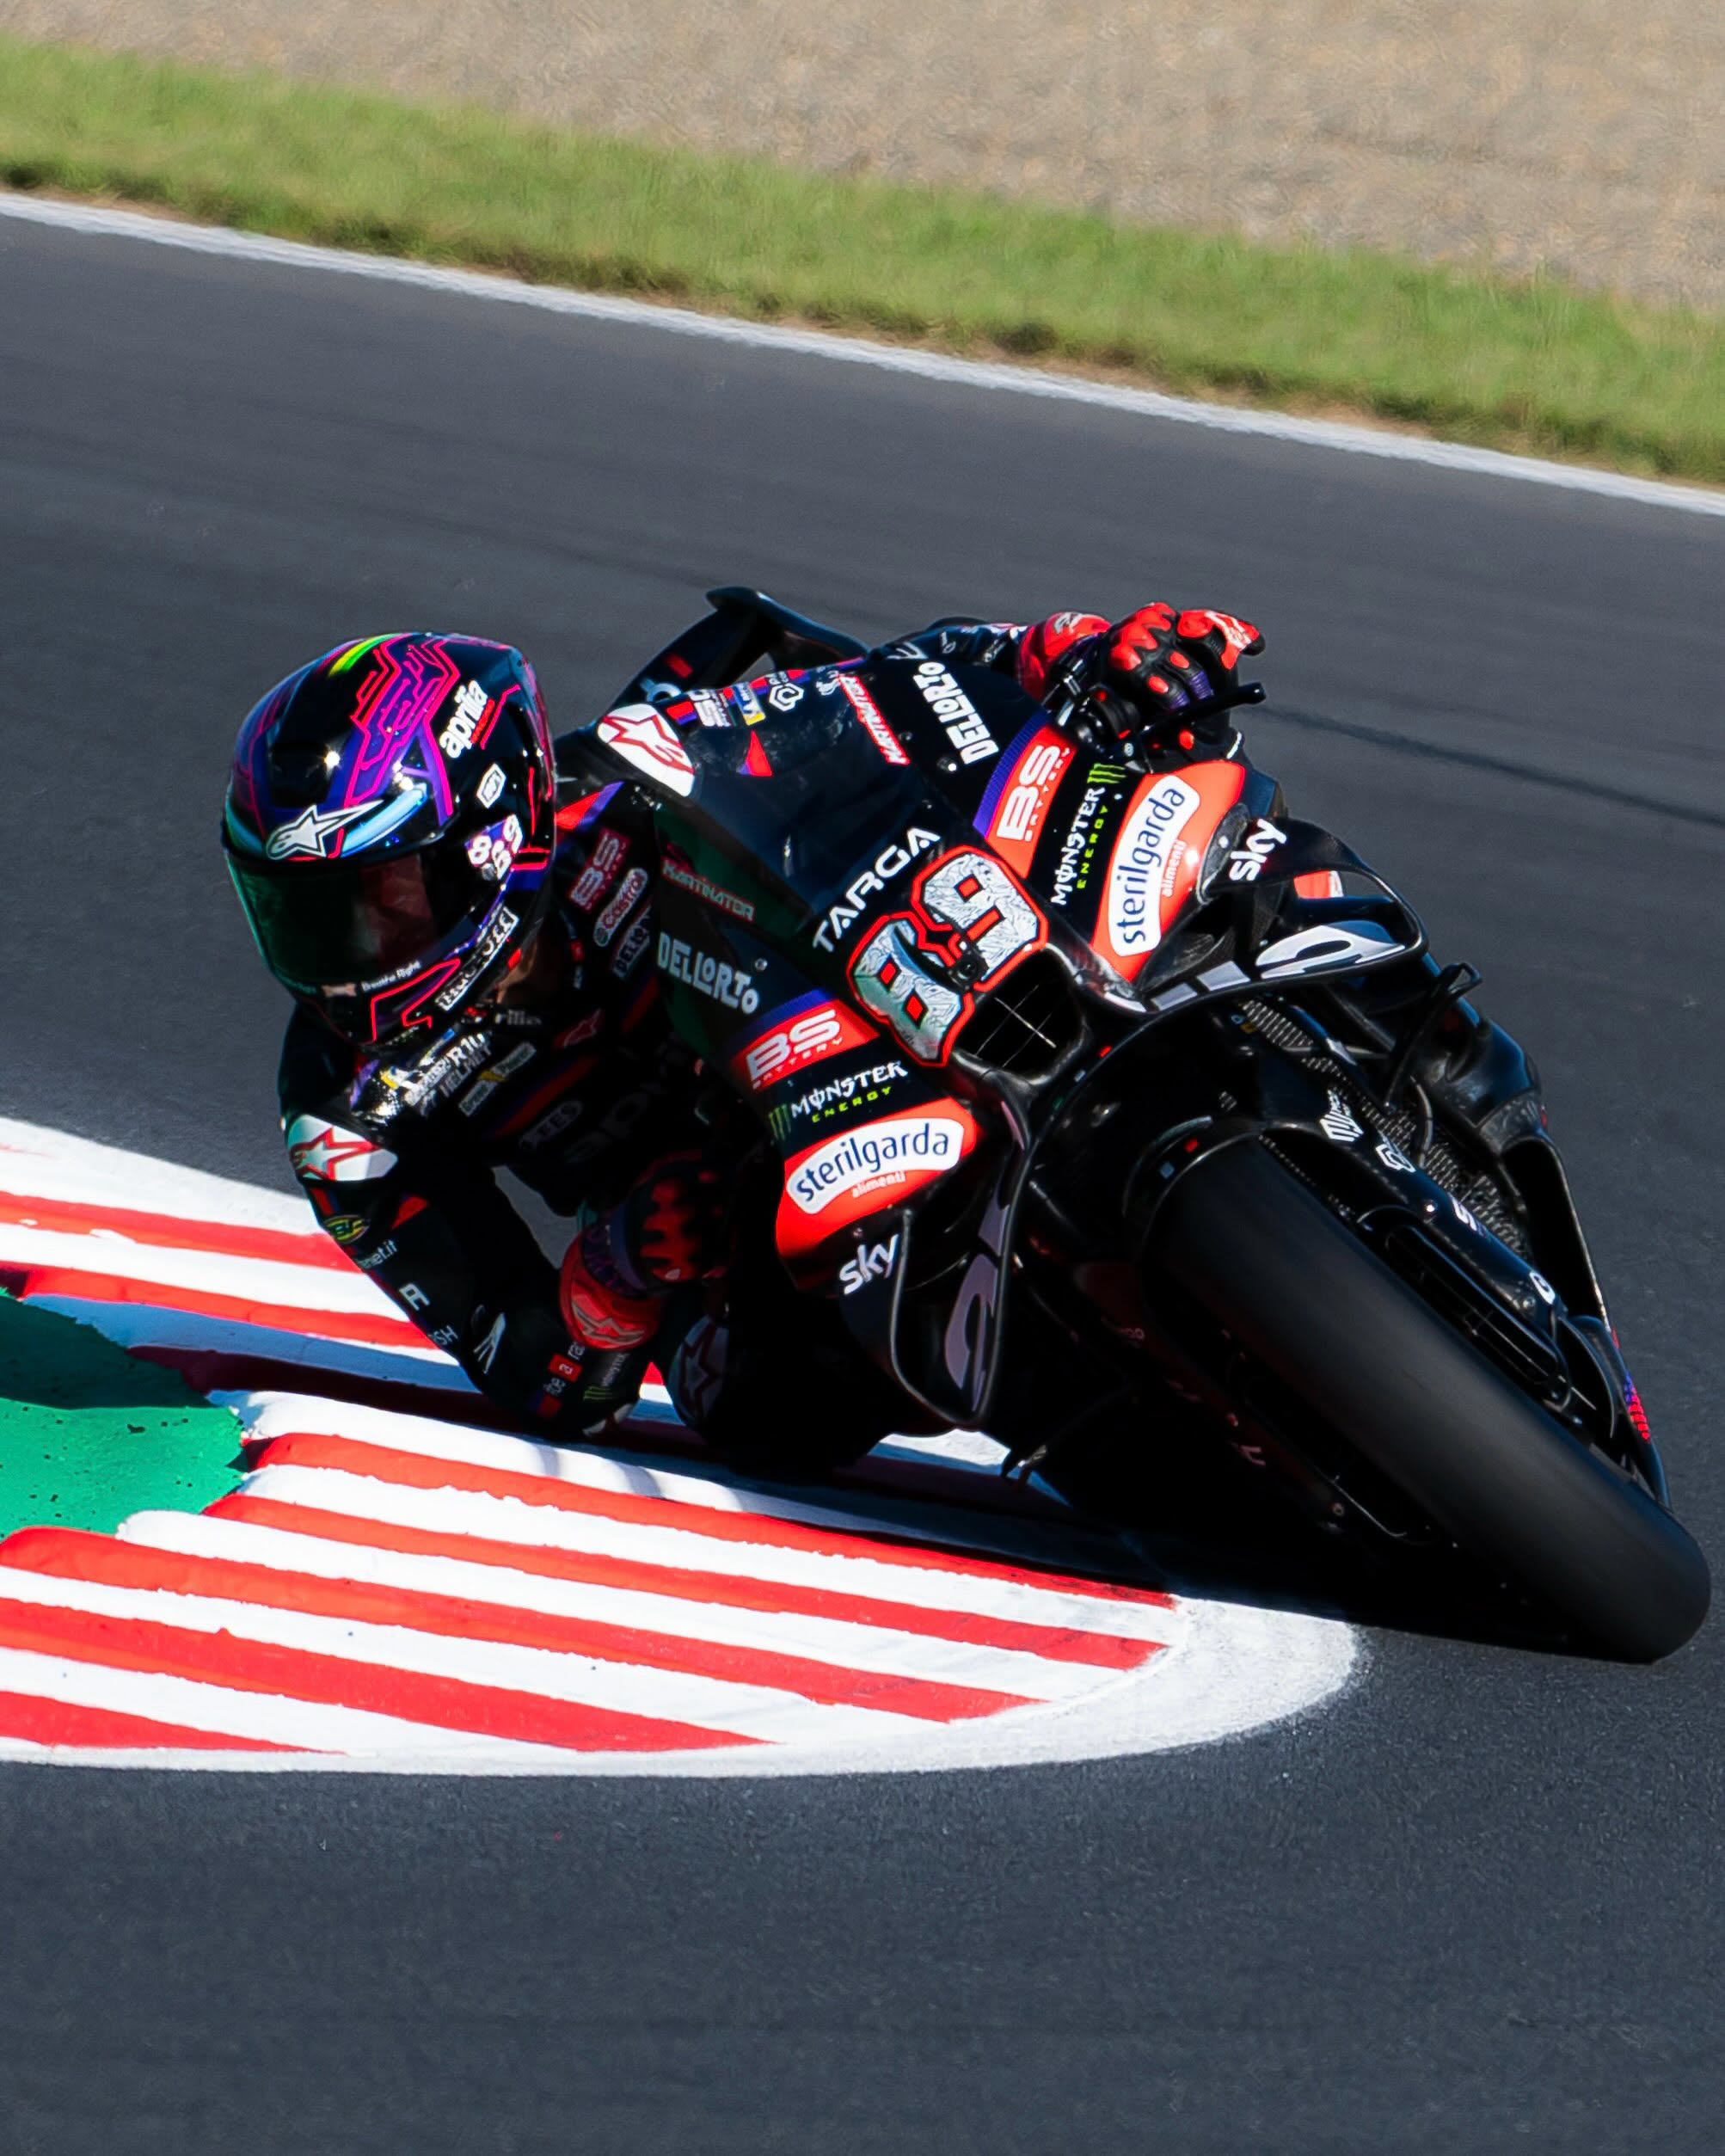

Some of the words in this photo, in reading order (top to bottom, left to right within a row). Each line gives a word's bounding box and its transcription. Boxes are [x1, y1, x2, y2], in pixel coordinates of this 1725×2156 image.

[439, 679, 489, 759] aprilia
[913, 661, 1000, 764] DELLORTO
[997, 744, 1062, 840] BS
[1051, 786, 1107, 905] MONSTER
[1077, 805, 1108, 890] ENERGY
[1117, 788, 1185, 944] sterilgarda
[1230, 819, 1286, 882] sky
[813, 827, 941, 954] TARGA
[657, 931, 759, 1014] DELLORTO
[845, 845, 1048, 1066] 89
[746, 1009, 841, 1079] BS
[790, 1060, 909, 1118] MONSTER
[812, 1086, 893, 1123] ENERGY
[796, 1123, 949, 1201] sterilgarda
[852, 1170, 907, 1199] alimenti
[838, 1234, 899, 1296] sky
